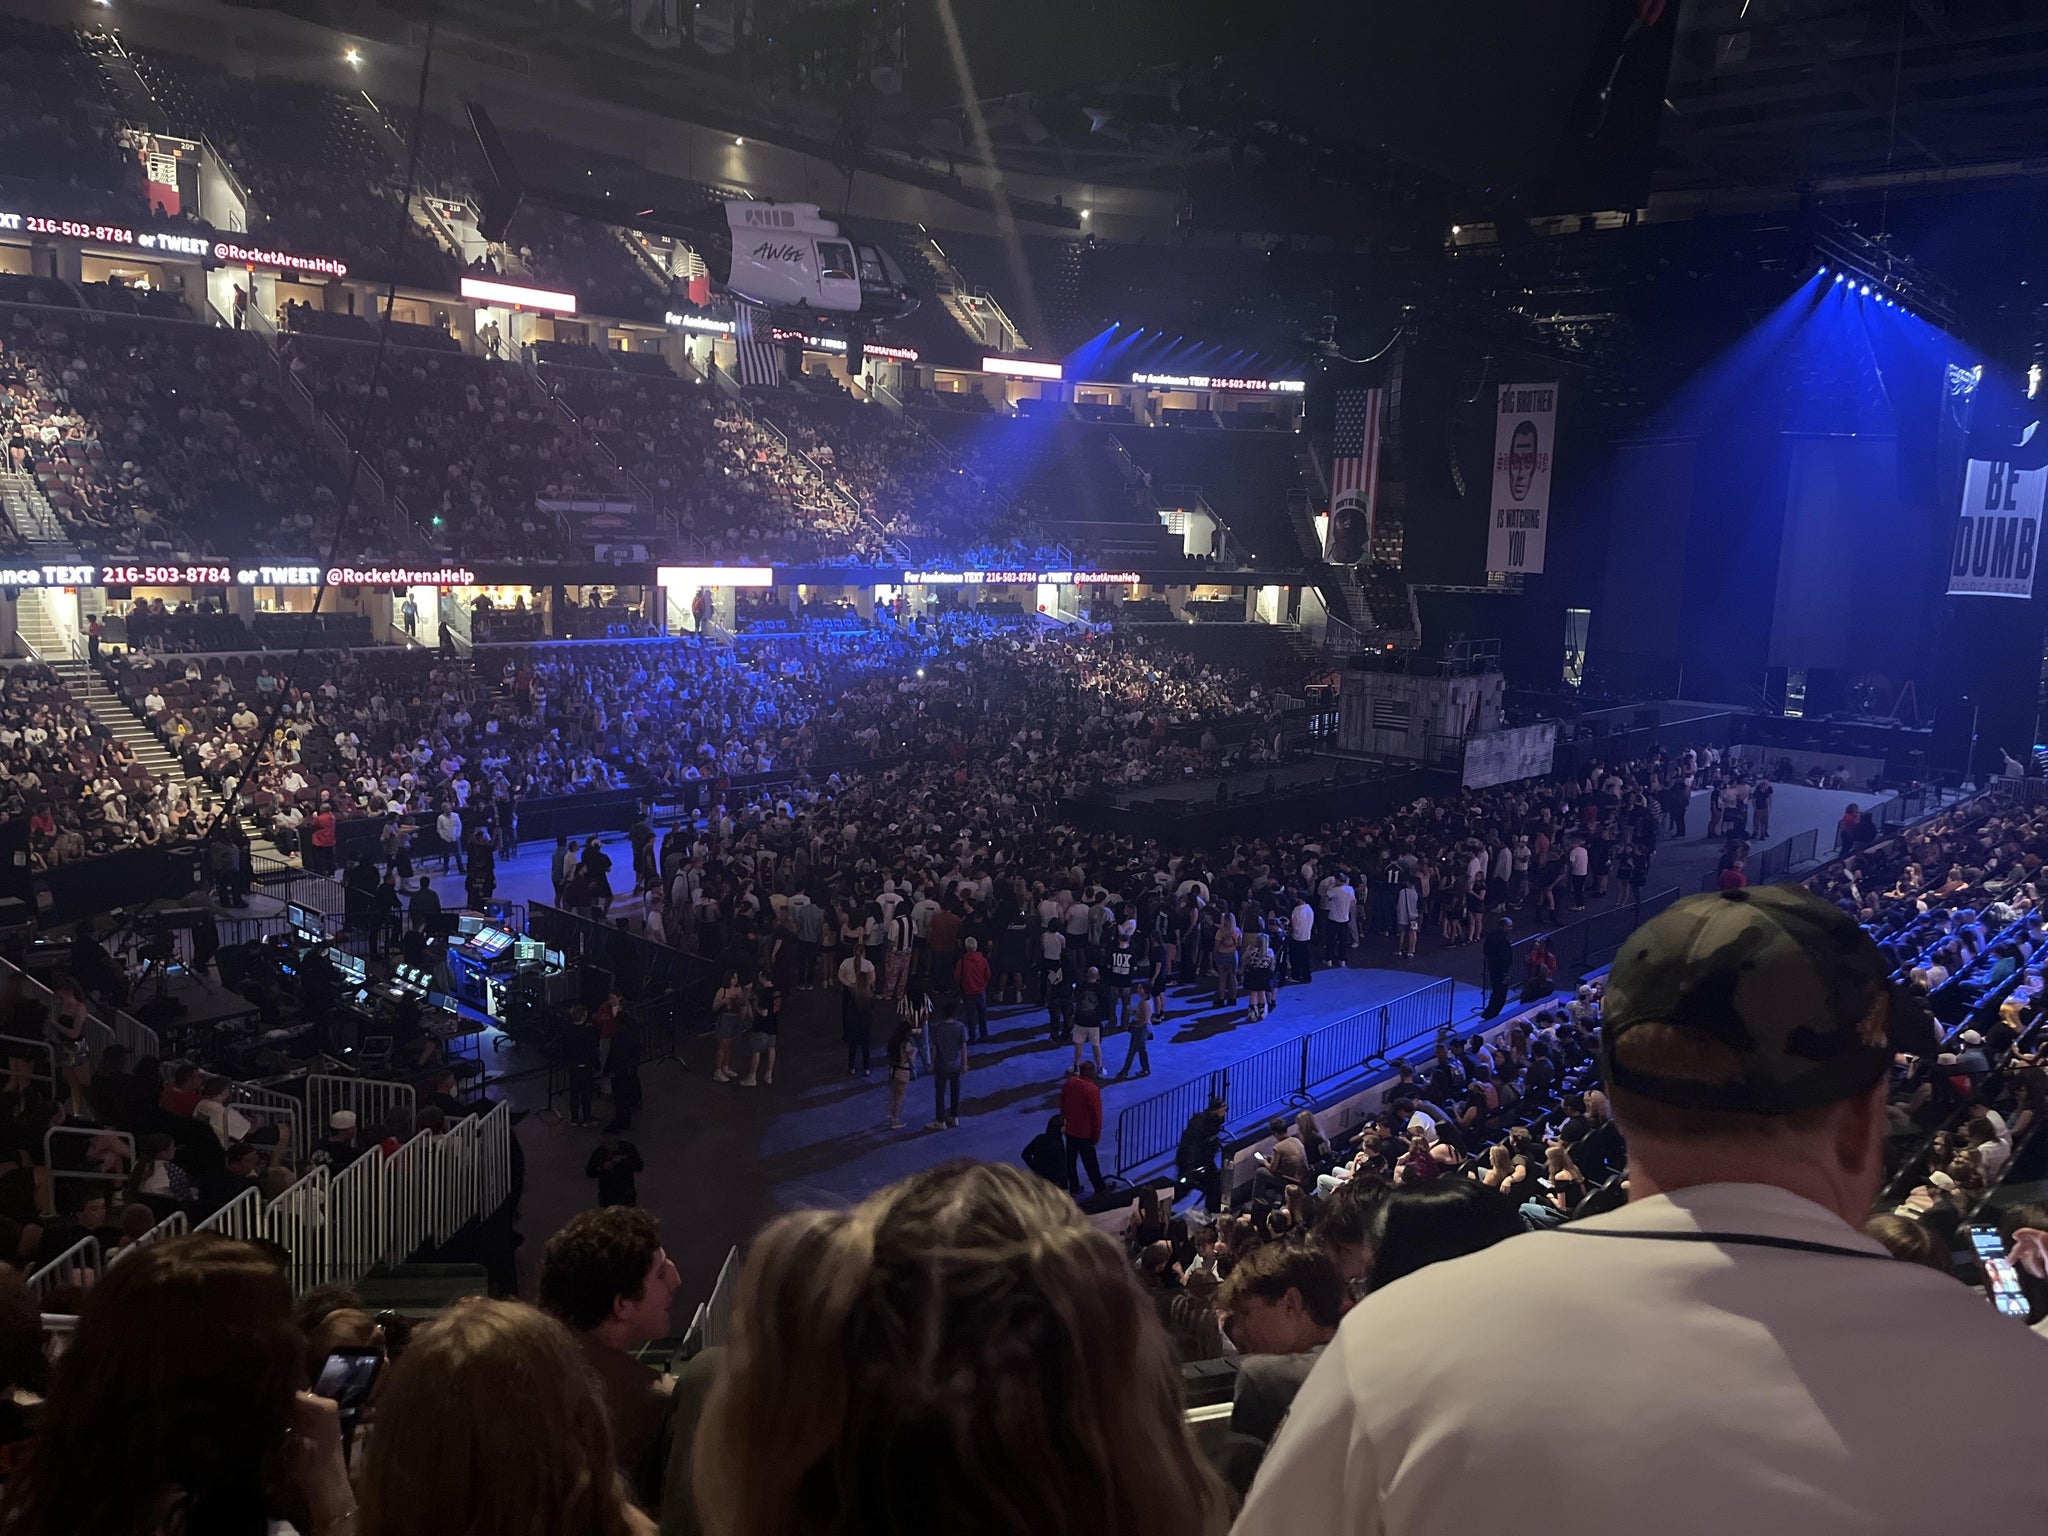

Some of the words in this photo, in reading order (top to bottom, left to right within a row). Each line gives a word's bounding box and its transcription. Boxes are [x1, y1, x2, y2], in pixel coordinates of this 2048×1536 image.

[26, 216, 133, 244] 216-503-8784
[138, 234, 157, 248] or
[157, 234, 210, 256] TWEET
[213, 243, 347, 277] @RocketArenaHelp
[753, 241, 808, 264] AWGE
[1132, 372, 1147, 384] For
[1189, 376, 1210, 388] TEXT
[1211, 378, 1267, 391] 216-503-8784
[1268, 381, 1279, 391] or
[1502, 391, 1514, 413] BIG
[1516, 390, 1553, 413] BROTHER
[1985, 461, 2020, 511] BE
[1497, 509, 1504, 529] IS
[1506, 508, 1540, 530] WATCHING
[1508, 531, 1527, 567] YOU
[1952, 516, 2037, 580] DUMB
[41, 566, 95, 584] TEXT
[101, 566, 231, 583] 216-503-8784
[237, 569, 259, 585] or
[260, 566, 321, 584] TWEET
[326, 567, 475, 586] @RocketArenaHelp
[904, 571, 919, 584] For
[920, 571, 963, 584] Assistance
[964, 571, 984, 583] TEXT
[985, 572, 1037, 583] 216-503-8784
[1038, 573, 1047, 583] or
[1048, 571, 1072, 583] TWEET
[1073, 572, 1140, 584] @RocketArenaHelp
[1387, 869, 1400, 884] 11
[1112, 952, 1133, 967] 10X
